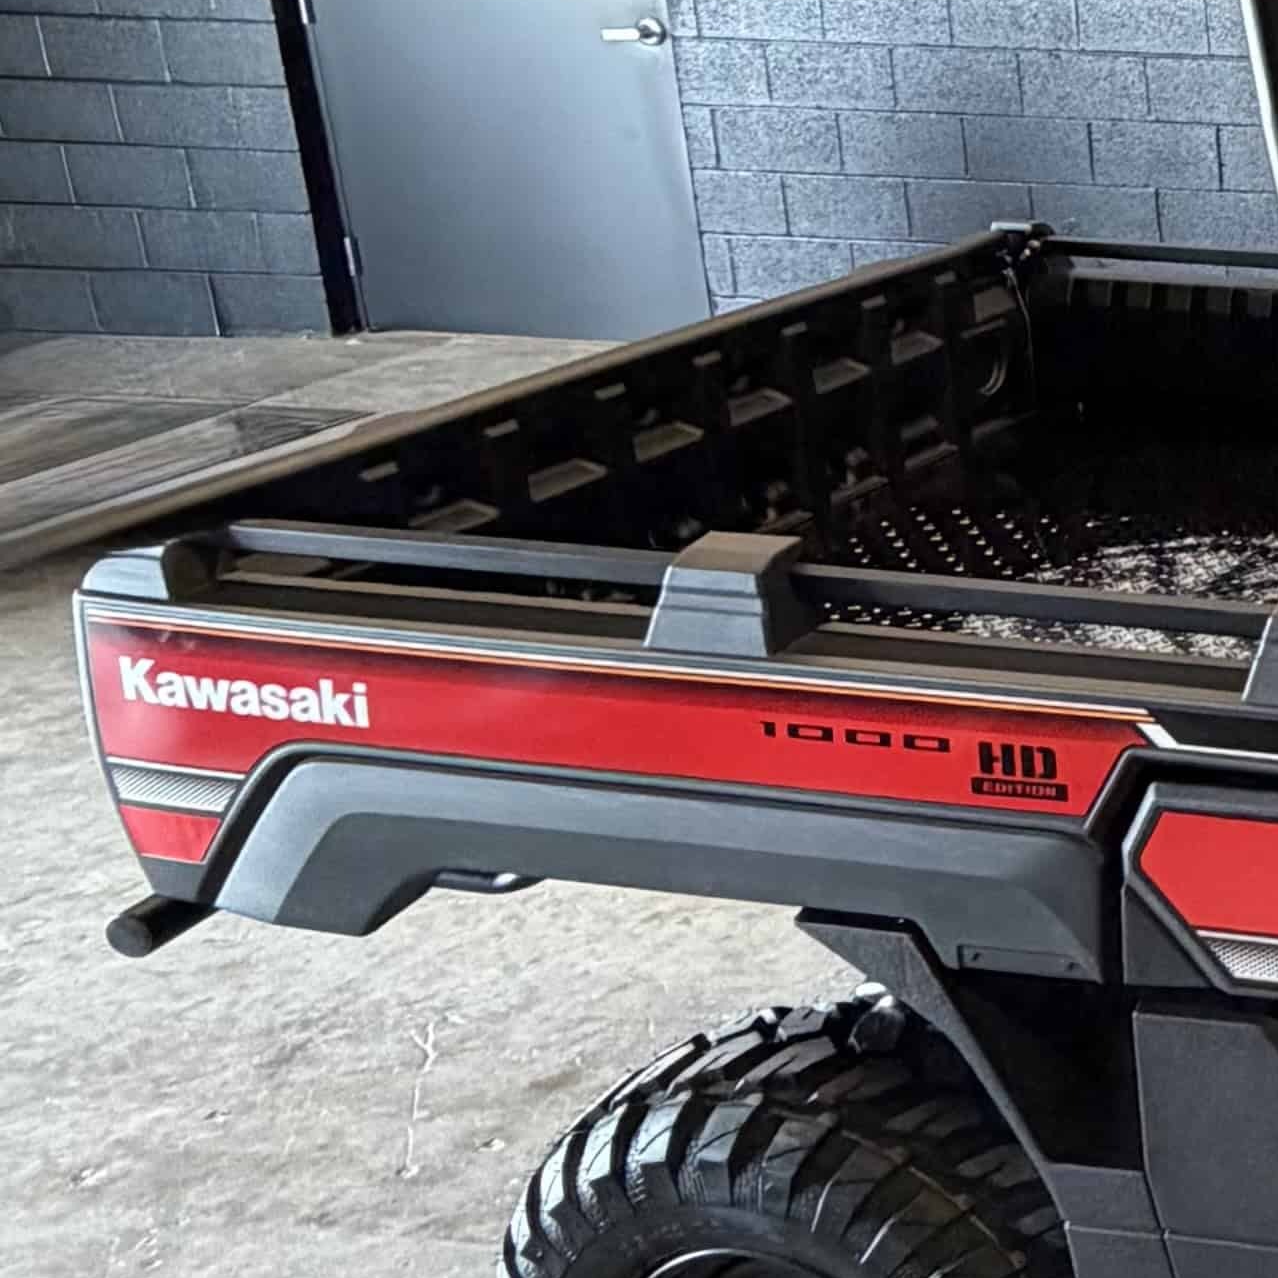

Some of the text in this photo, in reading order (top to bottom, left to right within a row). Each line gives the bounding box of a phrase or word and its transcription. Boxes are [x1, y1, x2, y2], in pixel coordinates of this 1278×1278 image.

[117, 654, 370, 729] Kawasaki
[759, 720, 1058, 780] 1000 HD
[980, 779, 1058, 798] EDITION
